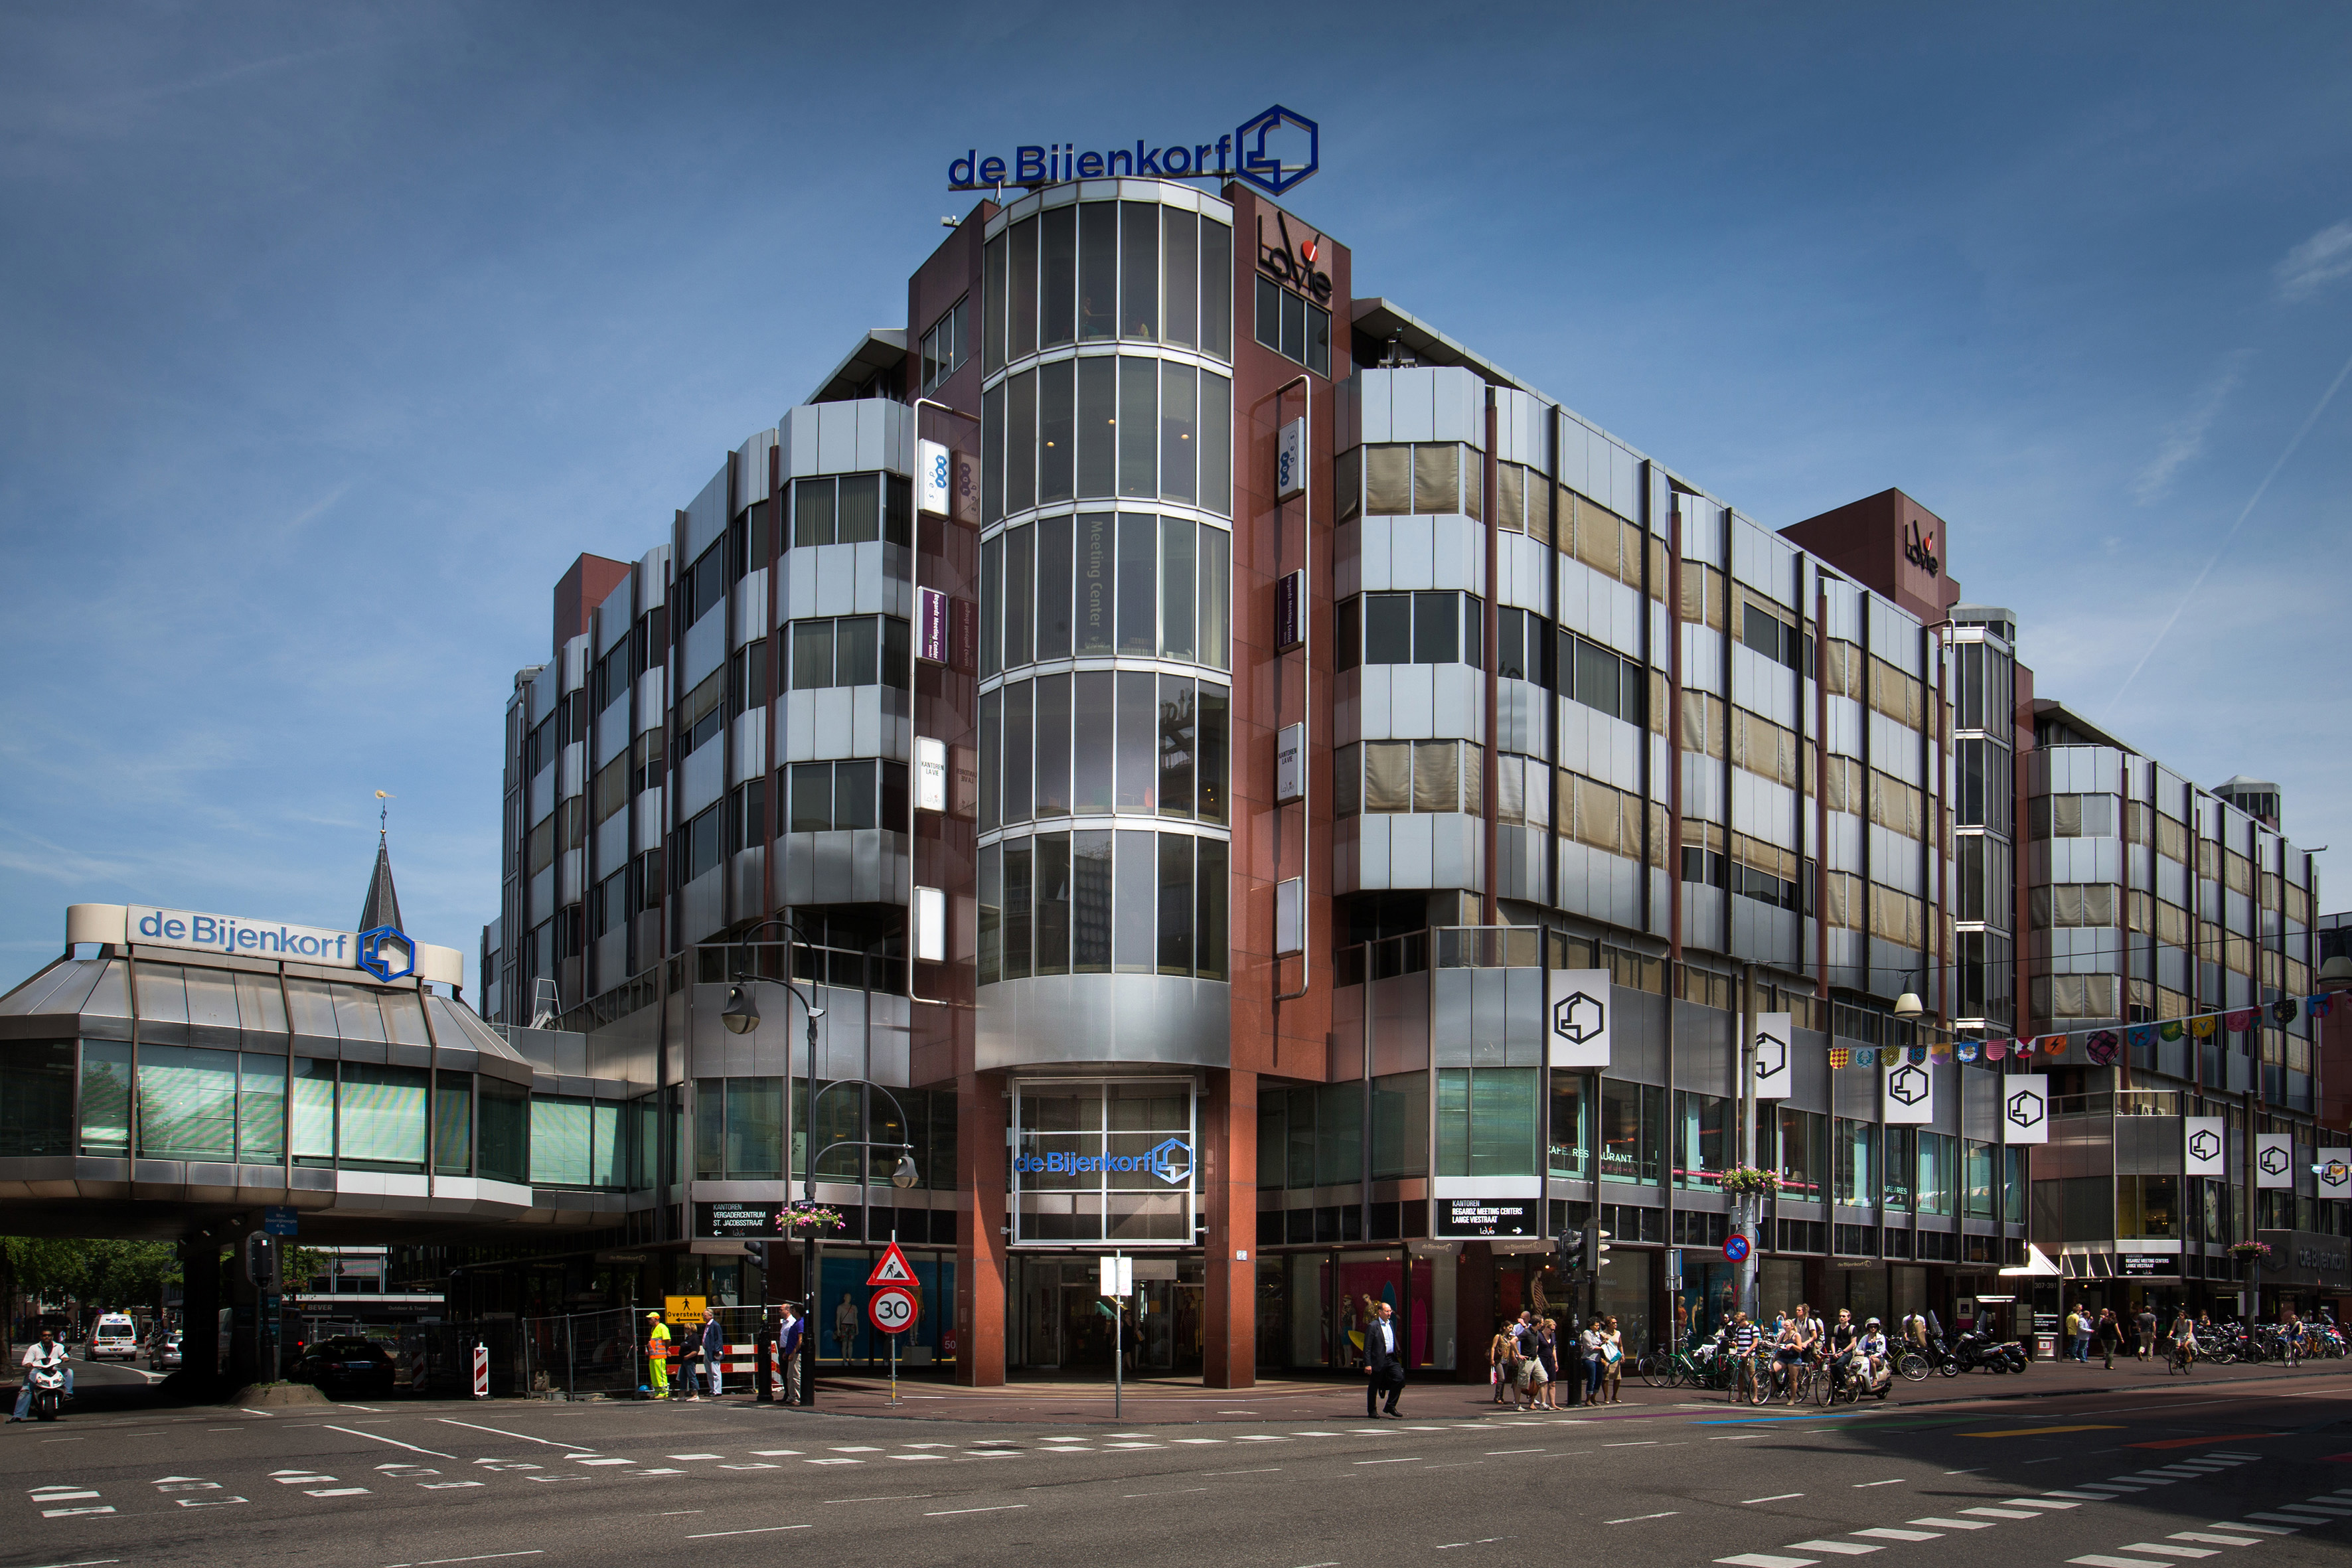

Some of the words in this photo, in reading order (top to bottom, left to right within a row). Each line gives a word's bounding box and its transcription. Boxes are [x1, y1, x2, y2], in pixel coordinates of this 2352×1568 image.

[949, 149, 1007, 187] de
[1016, 134, 1232, 184] Bijenkorf
[1087, 520, 1104, 578] Meeting
[1090, 582, 1103, 627] Center
[1279, 747, 1297, 759] KANTOREN
[921, 761, 944, 771] KANTOREN
[139, 911, 187, 940] de
[193, 915, 347, 959] Bijenkorf
[1909, 1048, 1924, 1059] 13
[1014, 1152, 1044, 1172] de
[1047, 1151, 1152, 1176] Bijenkorf
[2300, 1246, 2311, 1267] de
[878, 1300, 910, 1319] 30
[944, 1340, 957, 1350] 50
